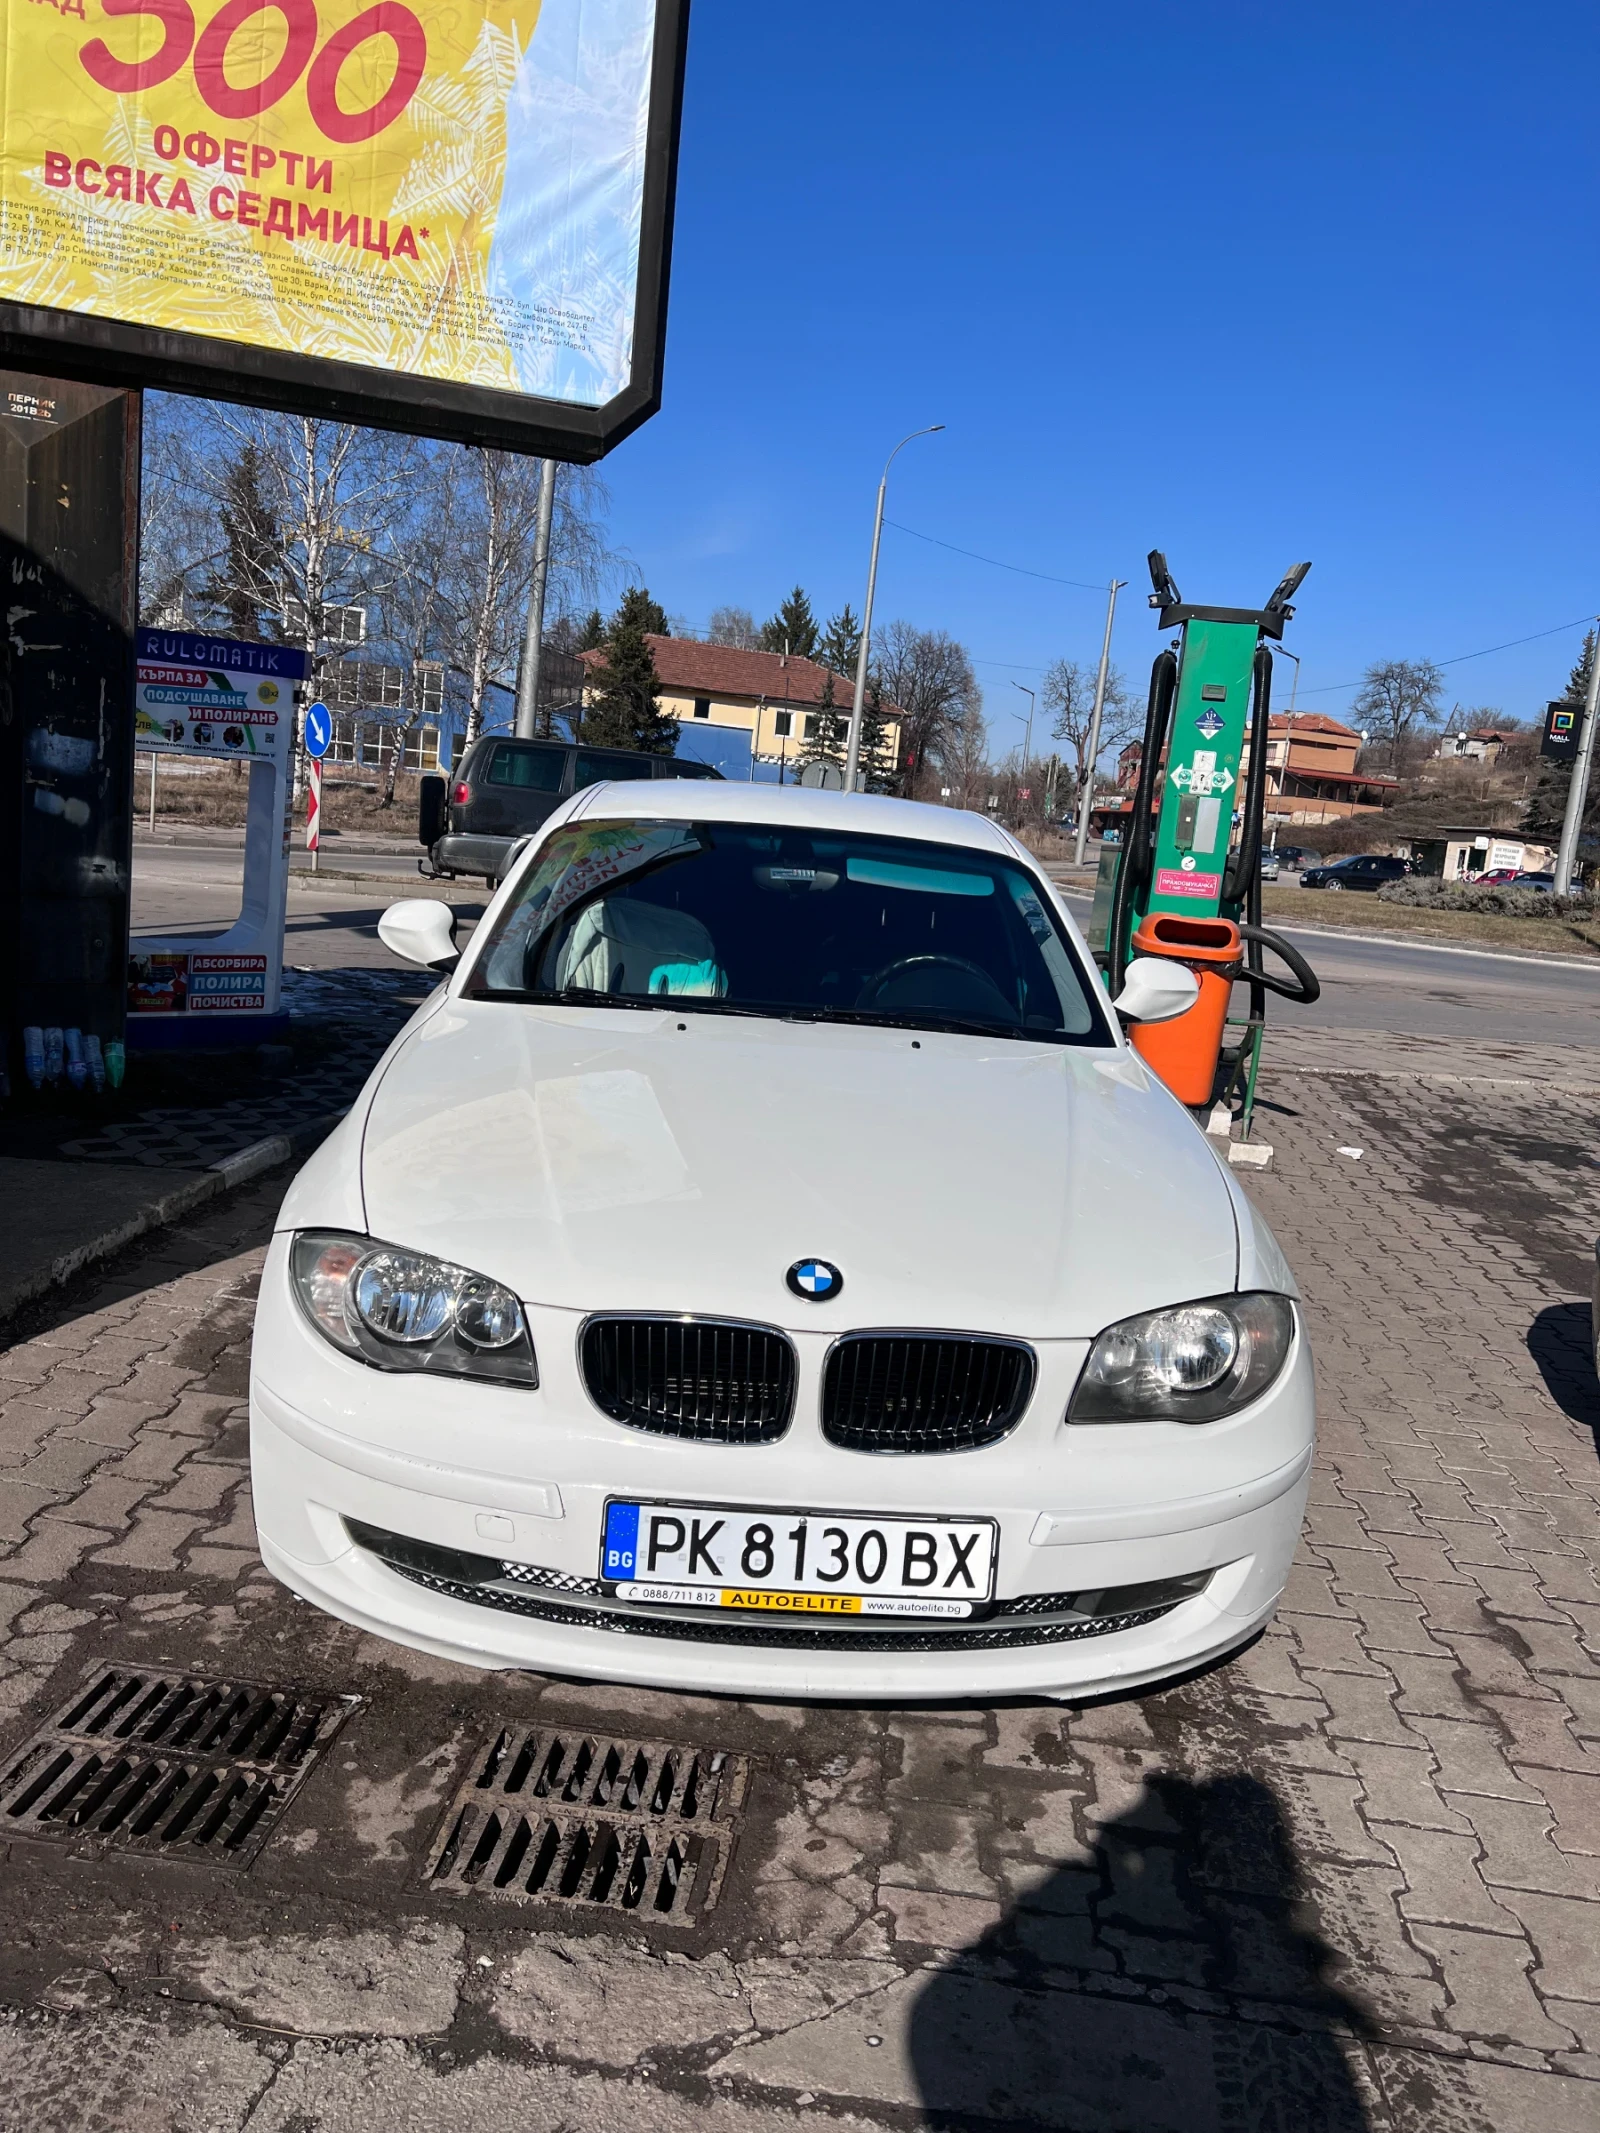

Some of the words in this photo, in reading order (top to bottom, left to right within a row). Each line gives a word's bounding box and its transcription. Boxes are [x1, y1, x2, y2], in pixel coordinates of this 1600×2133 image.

[153, 123, 333, 194] ОФЕРТИ
[44, 150, 196, 215] ВСЯКА
[53, 241, 71, 252] Цар
[72, 244, 105, 257] Симеон
[107, 251, 140, 264] Велики
[40, 208, 75, 220] артикул
[165, 231, 186, 242] брой
[253, 249, 291, 261] магазини
[532, 304, 547, 314] Цар
[548, 306, 595, 323] Освободител
[296, 299, 314, 309] Виж
[315, 304, 343, 314] повече
[8, 393, 56, 409] ПЕРНИК
[138, 668, 184, 683] КЪРПА
[186, 673, 202, 684] ЗА
[146, 689, 244, 706] ПОДСУШАВАНЕ
[192, 708, 202, 719] И
[204, 709, 277, 724] ПОЛИРАНЕ
[1549, 734, 1570, 742] MALL
[194, 958, 265, 968] АБСОРБИРА
[194, 976, 263, 990] ПОЛИРА
[192, 996, 262, 1008] ПОЧИСТВА
[608, 1550, 633, 1568] BG
[646, 1515, 726, 1576] PK
[741, 1523, 888, 1585] 8130
[901, 1531, 982, 1589] BX
[642, 1588, 693, 1602] 0888/711
[696, 1592, 716, 1604] 812
[731, 1594, 853, 1611] AUTOELITE
[867, 1601, 962, 1616] www.autoelite.bg
